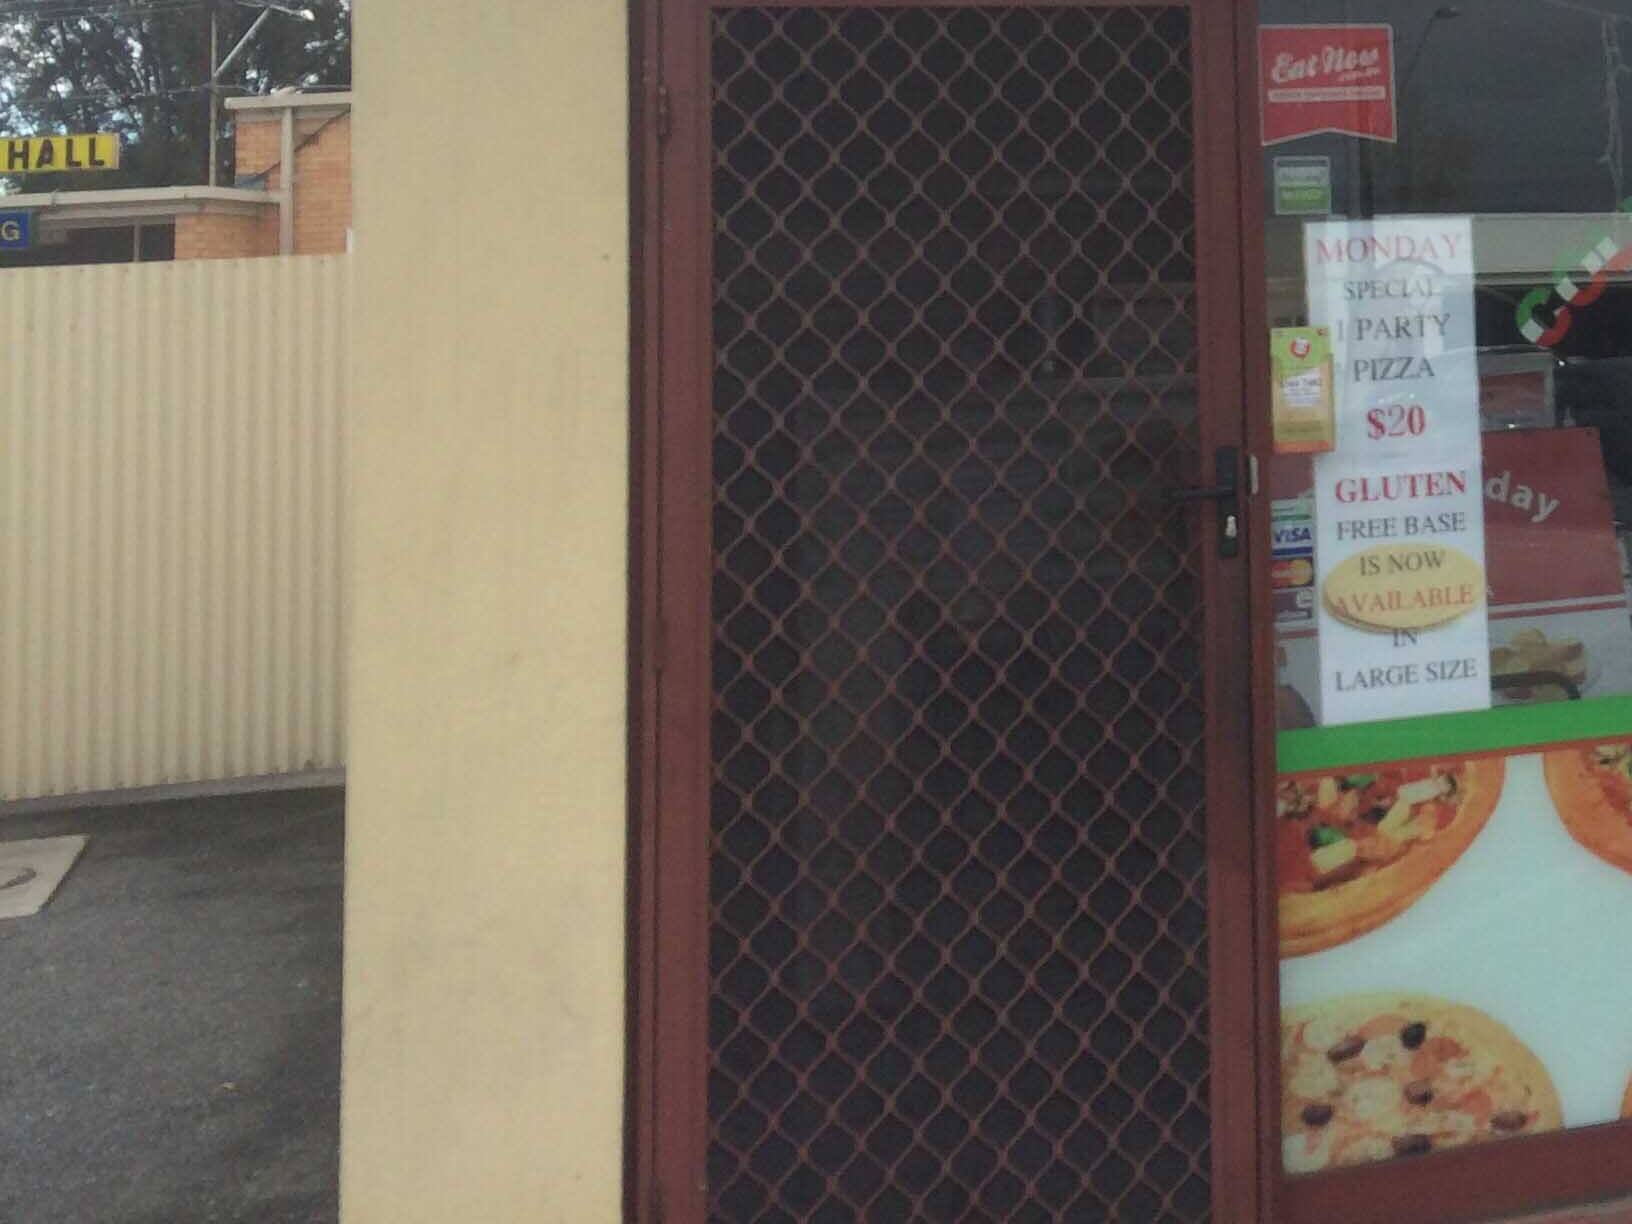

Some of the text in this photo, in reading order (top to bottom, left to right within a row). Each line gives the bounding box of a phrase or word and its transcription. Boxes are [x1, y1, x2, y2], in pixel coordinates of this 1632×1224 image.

[1271, 52, 1319, 84] Eat
[7, 137, 105, 170] HALL
[1315, 233, 1462, 265] MONDAY
[1342, 277, 1443, 301] SPECIAL
[1355, 313, 1451, 341] PARTY
[1352, 355, 1436, 382] PIZZA
[1366, 403, 1427, 440] $20
[1335, 469, 1468, 505] GLUTEN
[1274, 527, 1313, 544] VISA
[1335, 512, 1468, 541] FREE BASE
[1359, 550, 1447, 577] IS NOW
[1333, 583, 1475, 616] AVAILABLE
[1391, 628, 1418, 648] IN
[1335, 657, 1479, 692] LARGE SIZE
